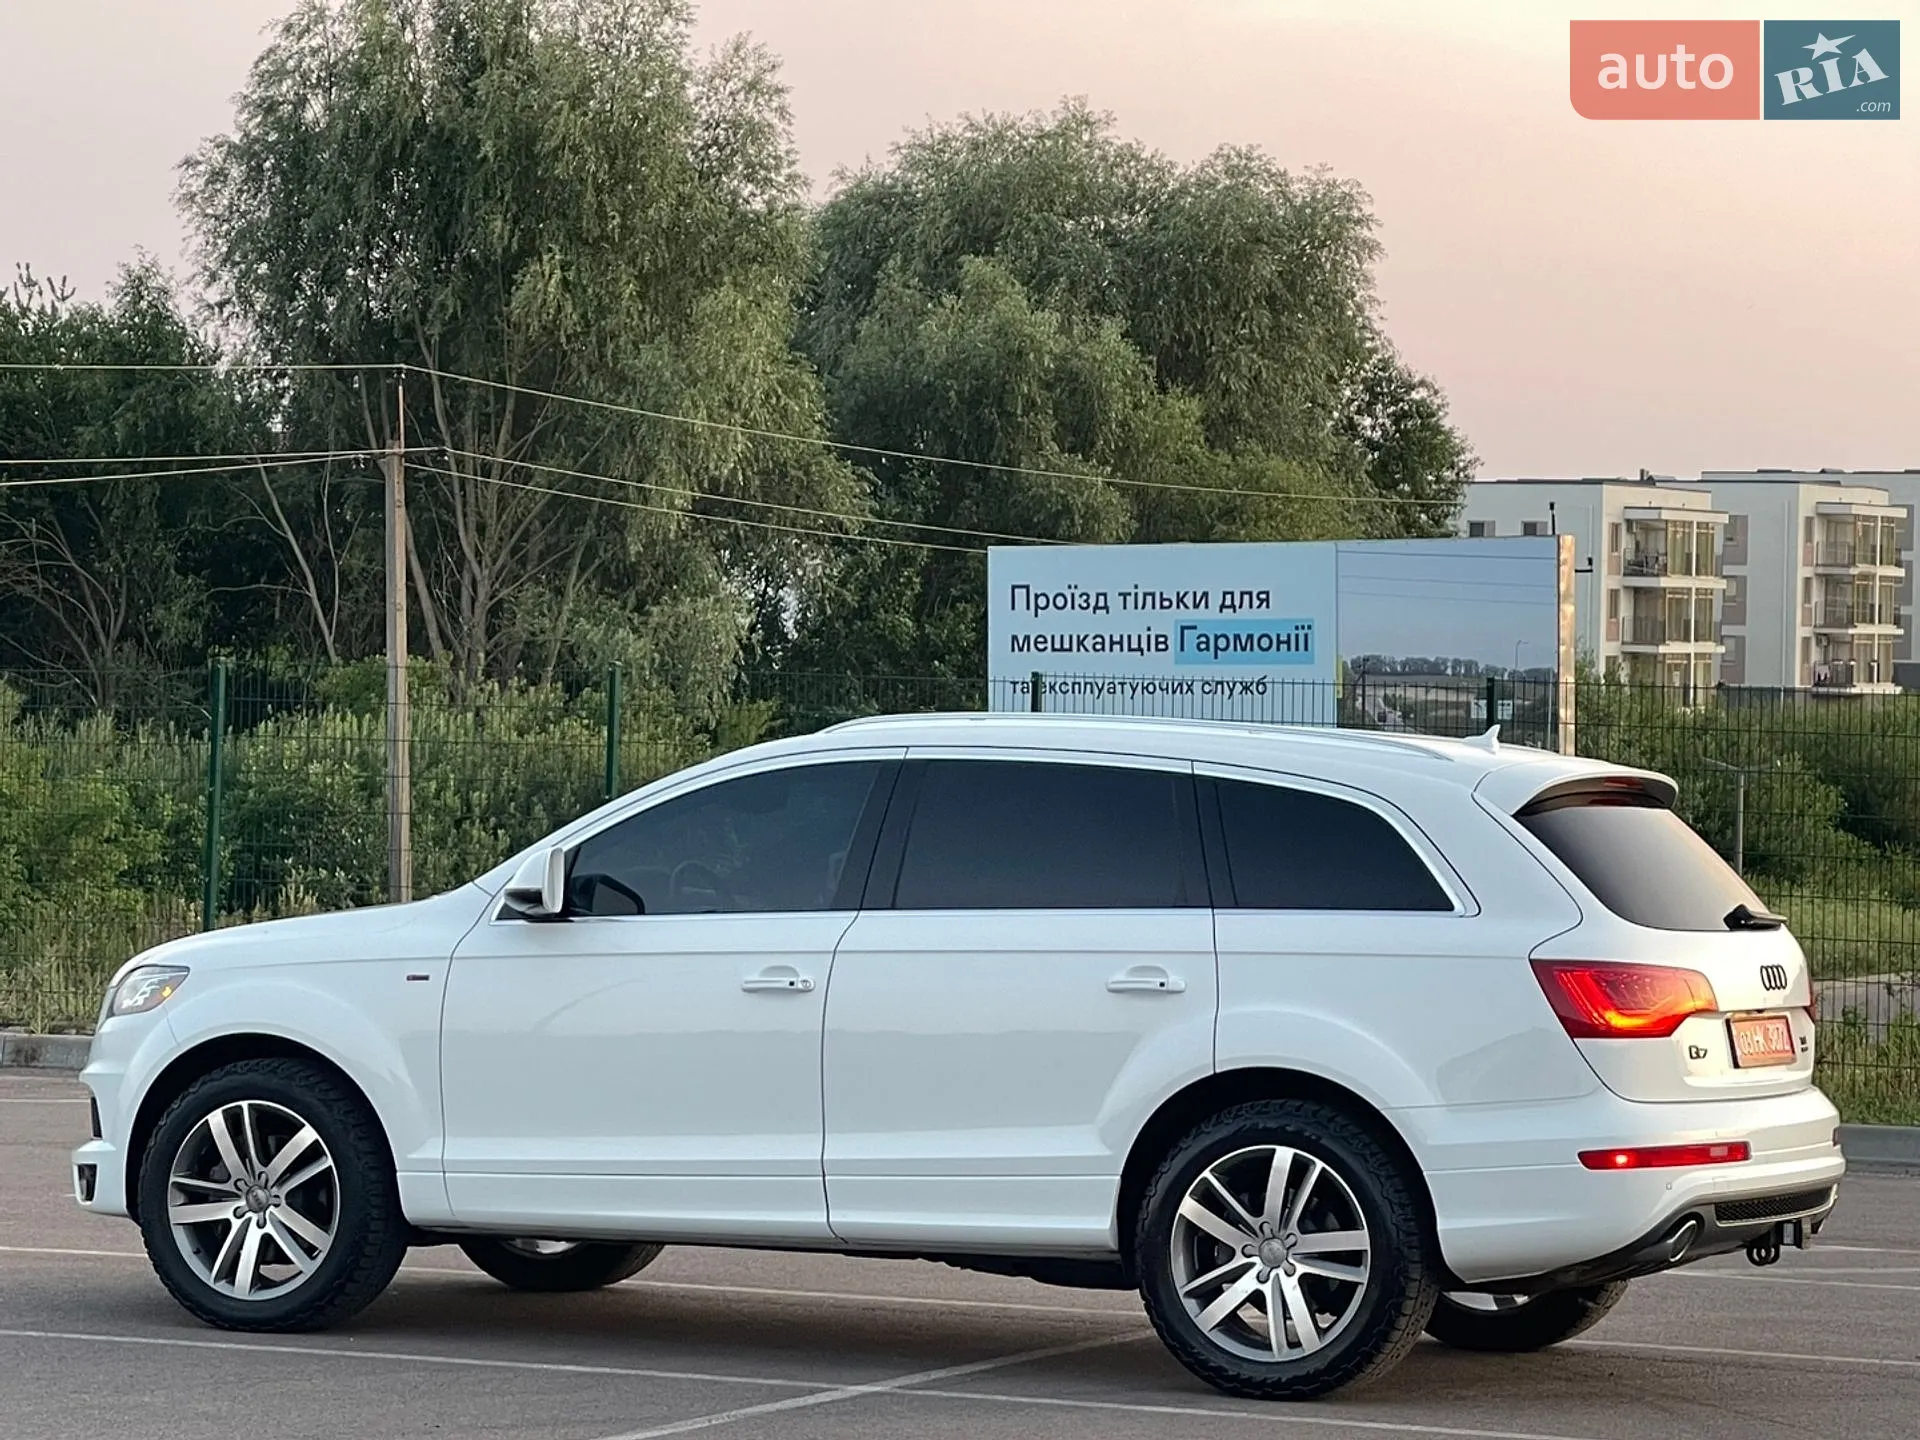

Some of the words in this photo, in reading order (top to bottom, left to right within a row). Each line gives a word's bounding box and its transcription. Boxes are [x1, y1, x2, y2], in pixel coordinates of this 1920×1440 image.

[1010, 584, 1110, 617] Проїзд
[1118, 584, 1210, 610] тільки
[1219, 589, 1271, 614] для
[1010, 626, 1170, 657] мешканців
[1179, 624, 1313, 660] Гармонії
[1010, 680, 1031, 695] та
[1201, 675, 1268, 700] служб
[1688, 1044, 1708, 1060] Q7
